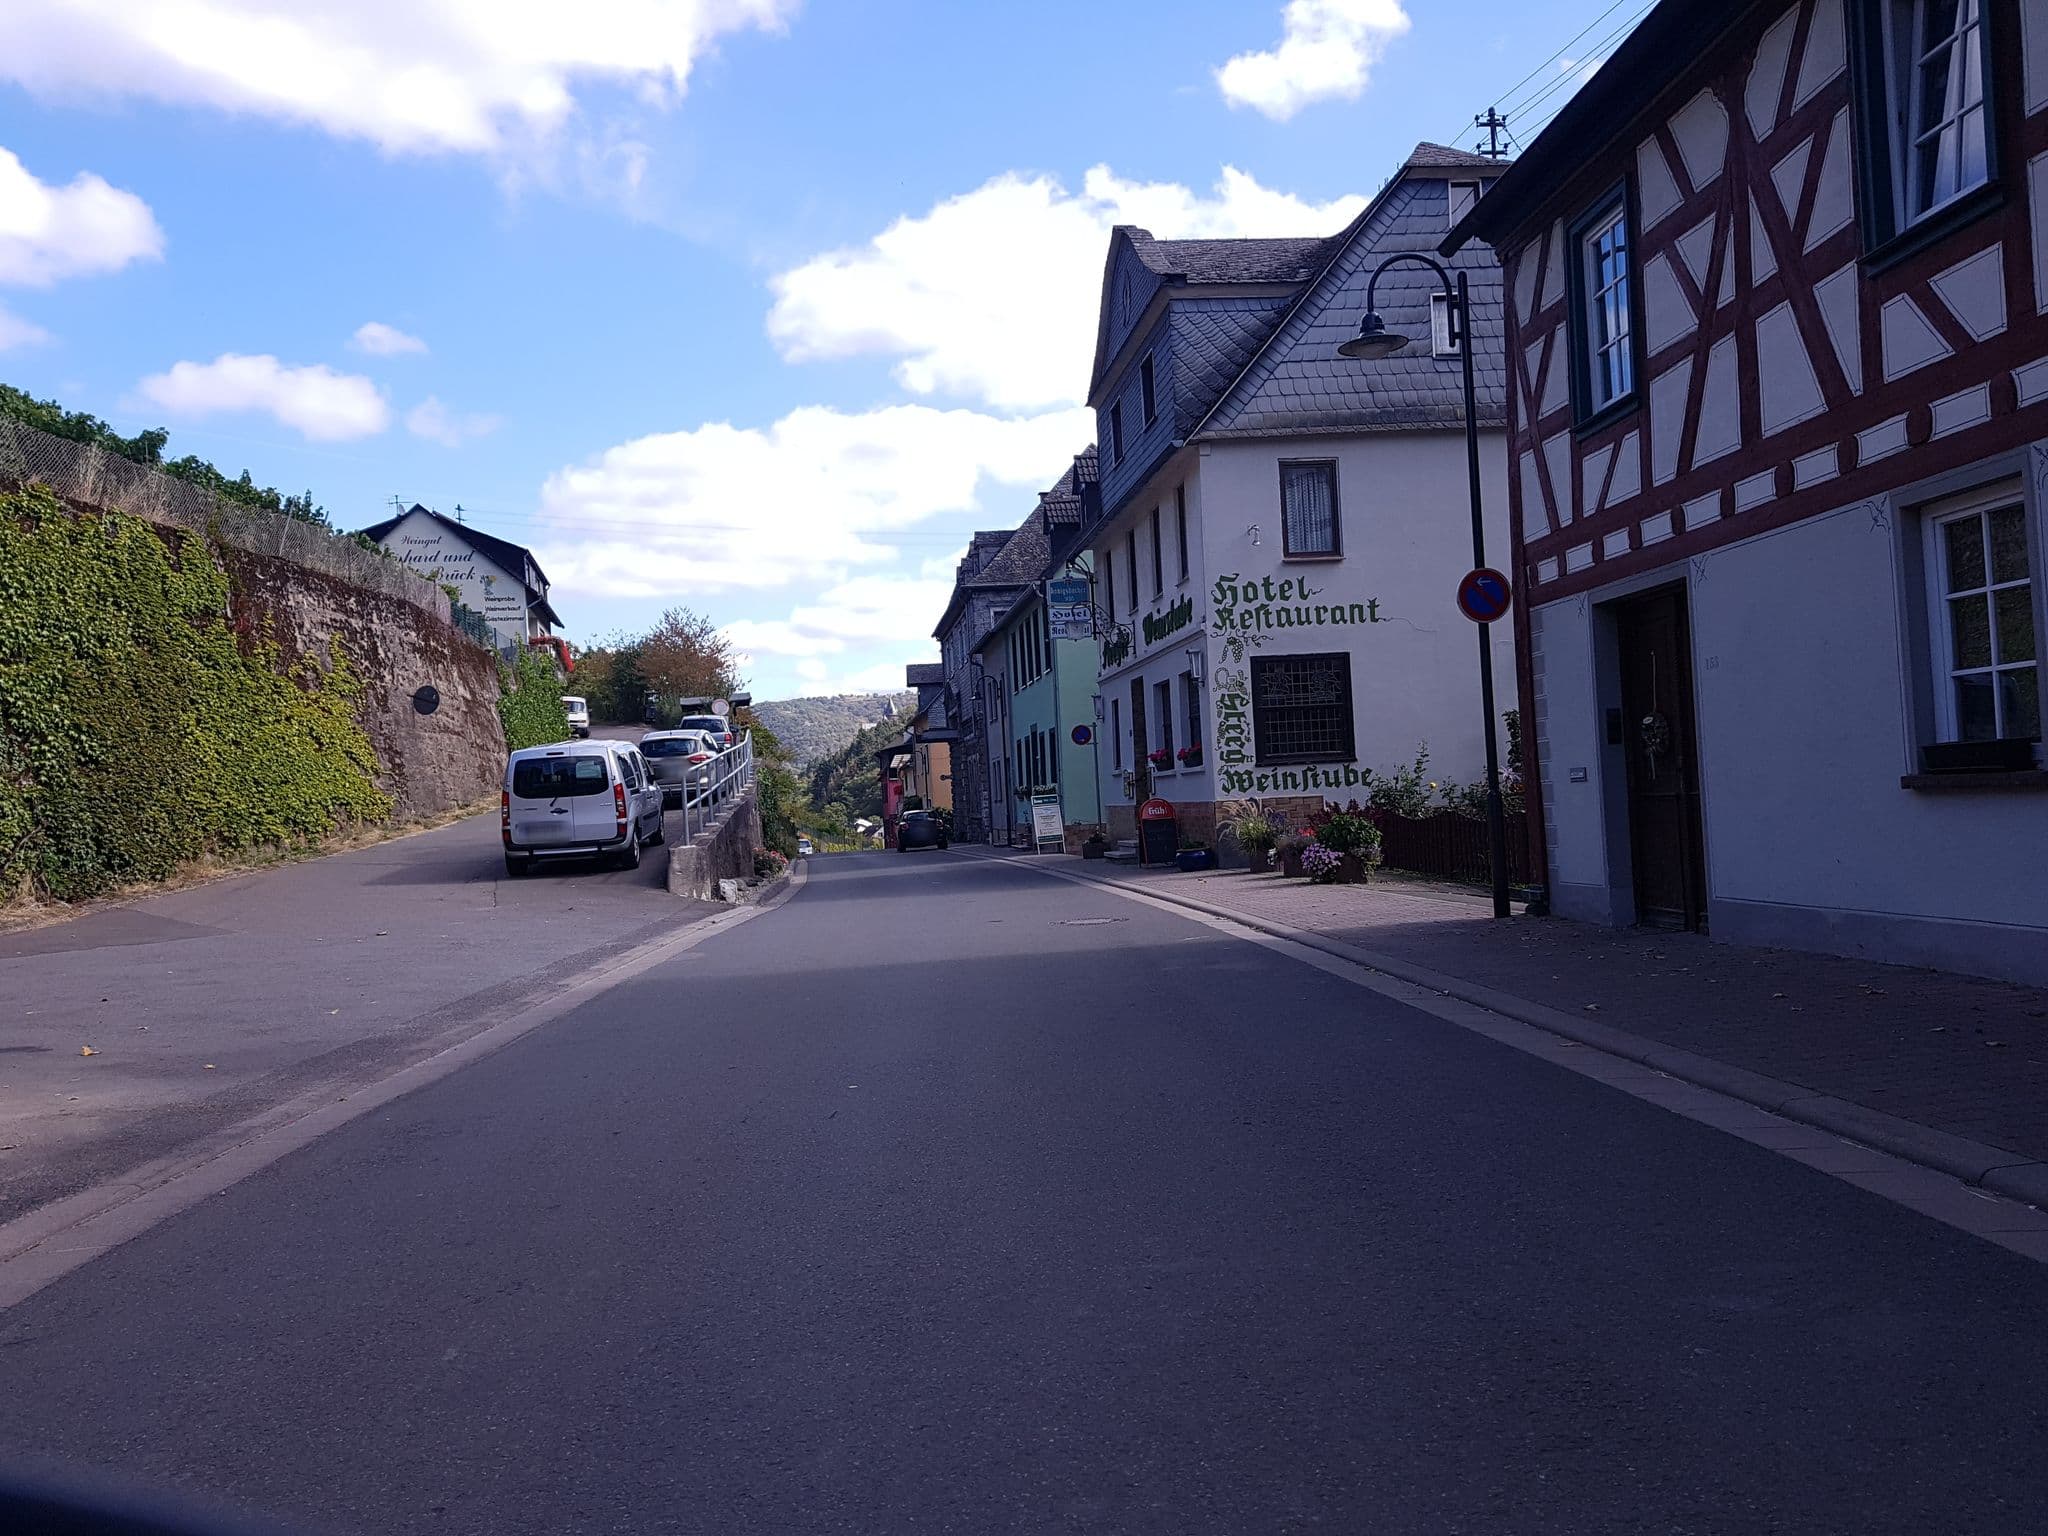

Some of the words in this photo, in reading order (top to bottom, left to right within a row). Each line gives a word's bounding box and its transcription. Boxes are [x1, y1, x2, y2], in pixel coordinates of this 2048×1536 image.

[401, 536, 442, 548] Weingut
[444, 549, 476, 562] und
[1211, 573, 1311, 607] Hotel
[1211, 597, 1380, 632] Restaurant
[1221, 764, 1374, 794] Weinstube
